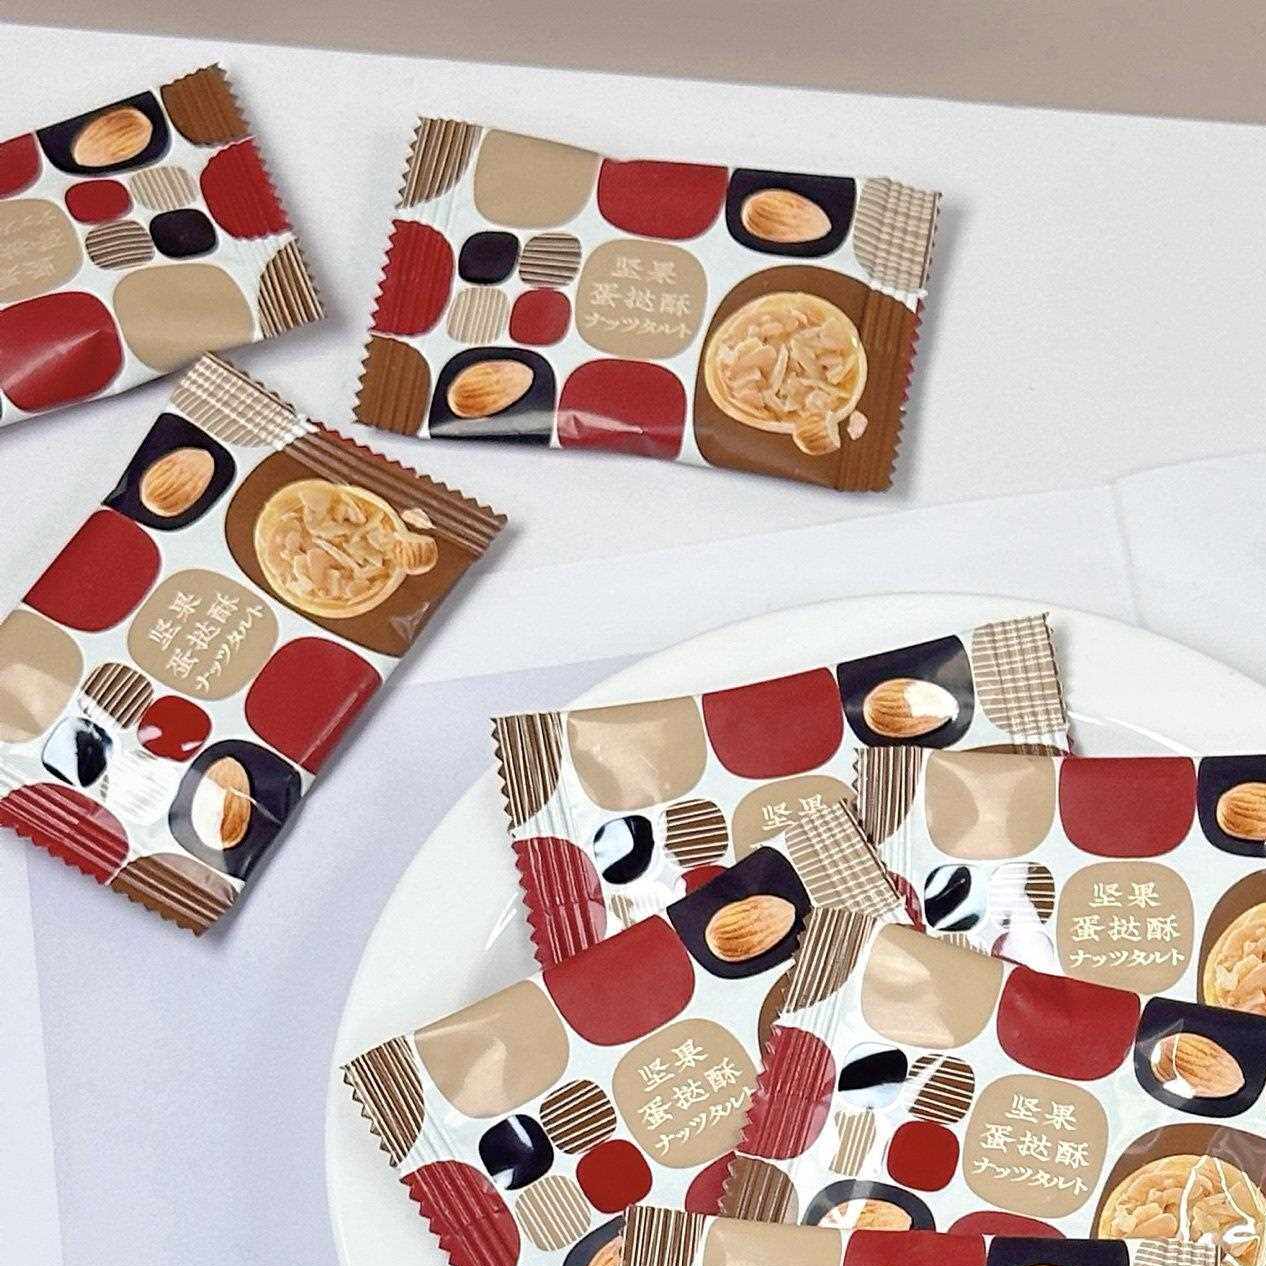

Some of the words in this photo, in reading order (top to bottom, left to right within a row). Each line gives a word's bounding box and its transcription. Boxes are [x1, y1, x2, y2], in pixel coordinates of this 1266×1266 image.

[612, 257, 676, 284] 坚果
[150, 591, 200, 650] 坚果
[1088, 882, 1162, 908] 坚果
[1071, 914, 1181, 942] 蛋挞酥
[1069, 948, 1186, 968] ナッツタルト
[638, 1038, 709, 1092] 坚果
[637, 1057, 743, 1130] 蛋挞酥
[1005, 1094, 1077, 1131] 坚果
[655, 1086, 756, 1157] ナッツタル
[979, 1123, 1090, 1169] 蛋挞酥
[972, 1156, 1088, 1196] ナッツタルト
